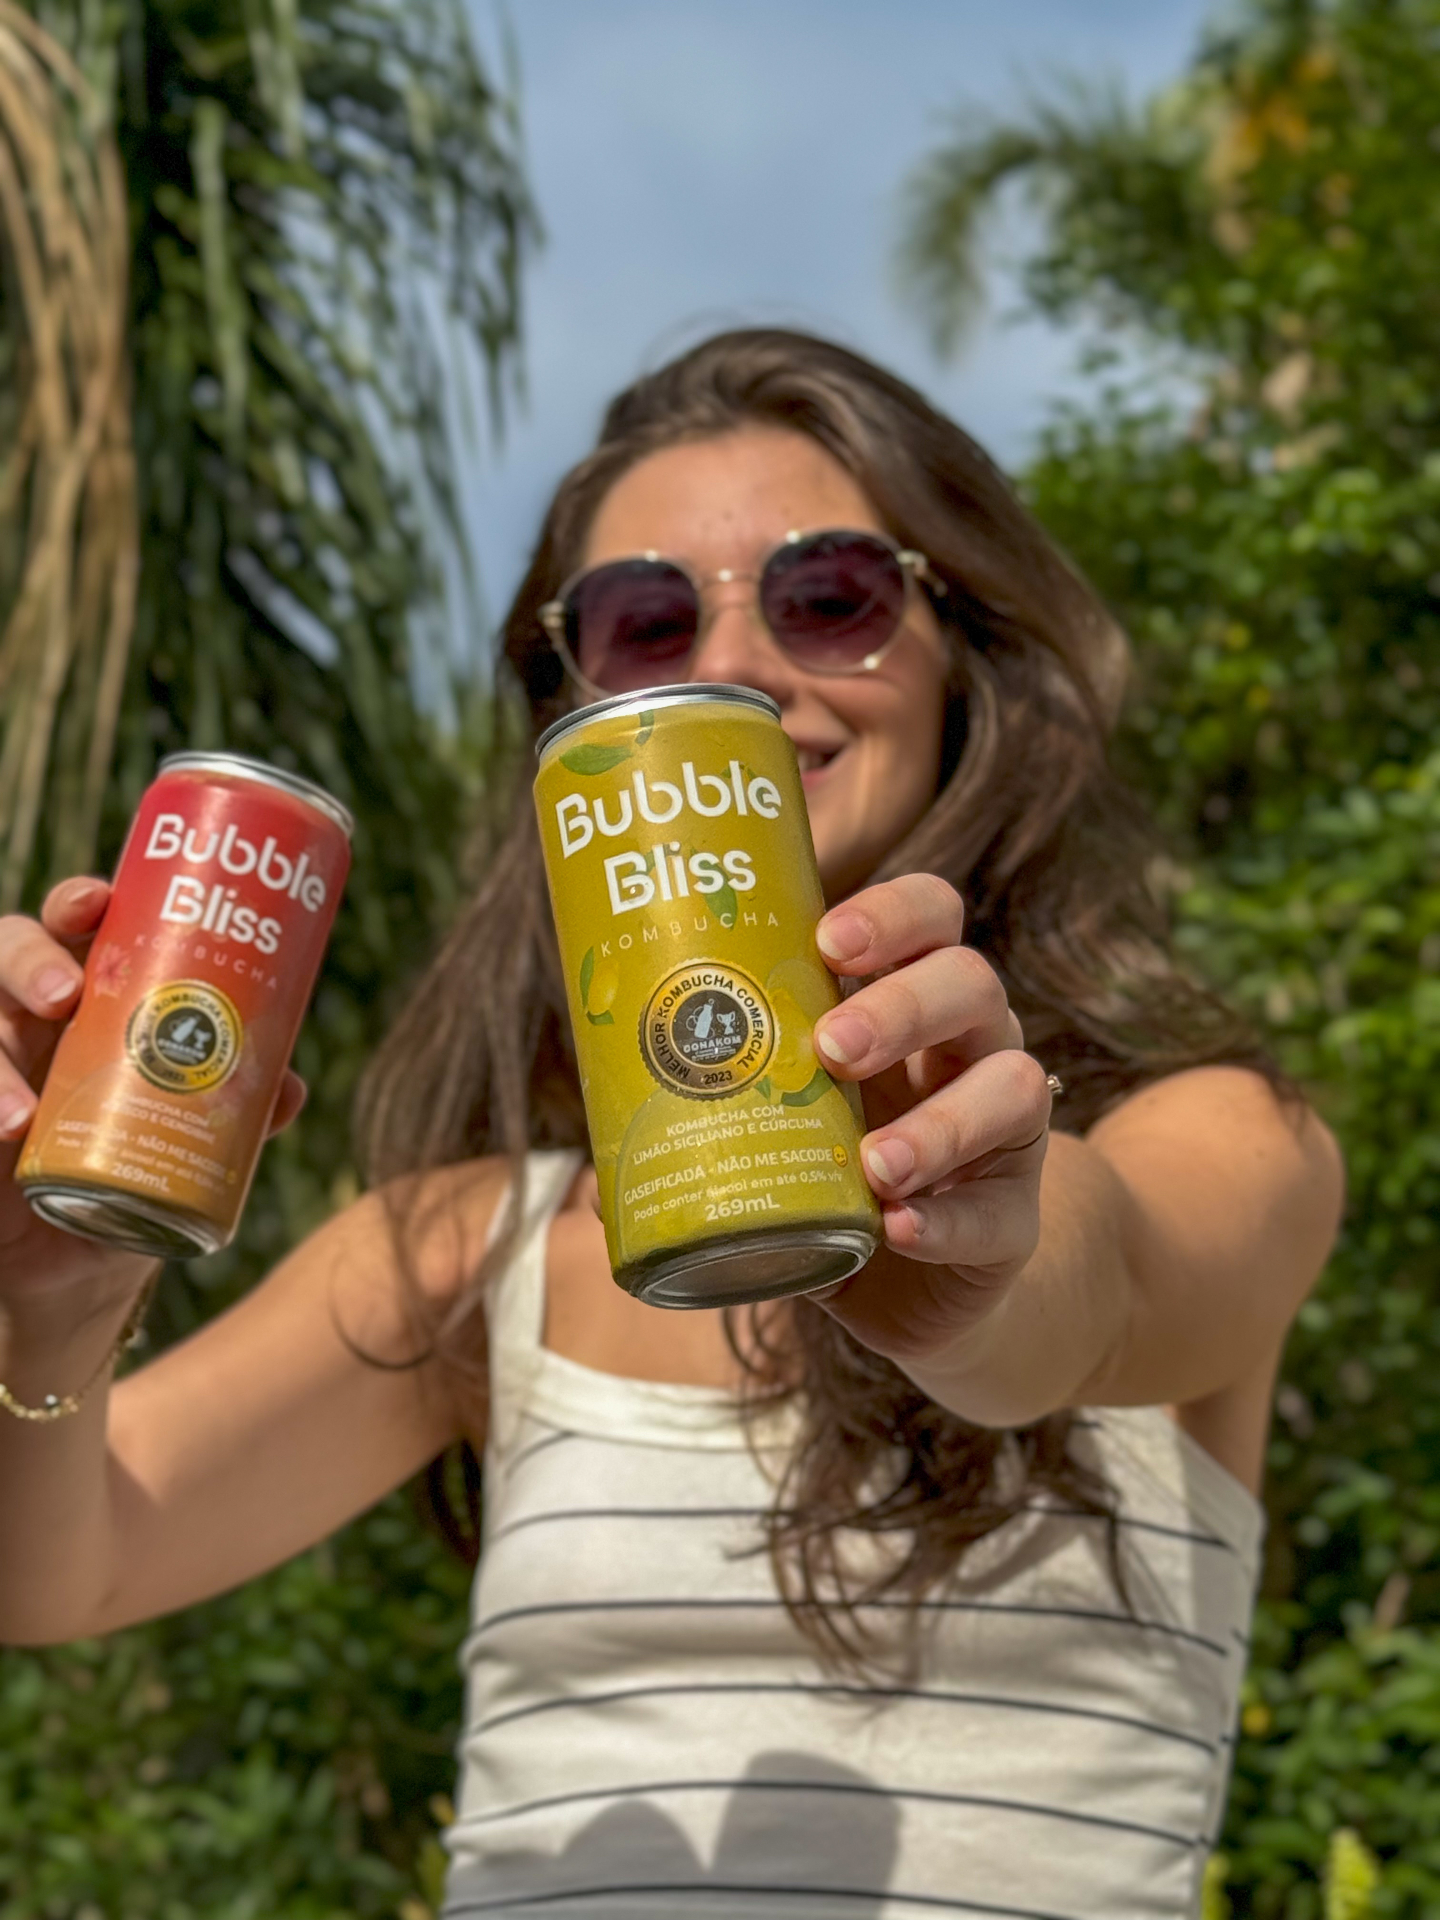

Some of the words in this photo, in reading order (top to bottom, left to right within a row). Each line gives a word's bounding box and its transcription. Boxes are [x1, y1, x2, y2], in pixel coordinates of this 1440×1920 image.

[555, 760, 782, 859] Bubble
[144, 813, 326, 912] Bubble
[603, 841, 757, 916] Bliss
[159, 874, 282, 954] Bliss
[601, 912, 779, 957] KOMBUCHA
[657, 974, 734, 1019] KOMBUCHA
[654, 1022, 691, 1079] MELHOR
[736, 988, 764, 1069] COMERCIAL
[703, 1070, 733, 1085] 2023
[633, 1142, 672, 1166] LIMÃO
[674, 1125, 744, 1151] SICILIANO
[747, 1122, 757, 1135] E
[760, 1117, 824, 1132] CÚRCUMA
[666, 1109, 750, 1137] KOMBUCHA
[751, 1103, 785, 1119] COM
[111, 1162, 171, 1193] 269mL
[624, 1164, 706, 1205] GASEIFICADA
[717, 1155, 752, 1174] NÃO
[754, 1151, 779, 1168] ME
[780, 1148, 833, 1164] SACODE
[633, 1203, 660, 1222] Pode
[662, 1188, 704, 1210] conter
[751, 1177, 773, 1189] em
[776, 1172, 797, 1186] até
[704, 1193, 780, 1222] 269mL
